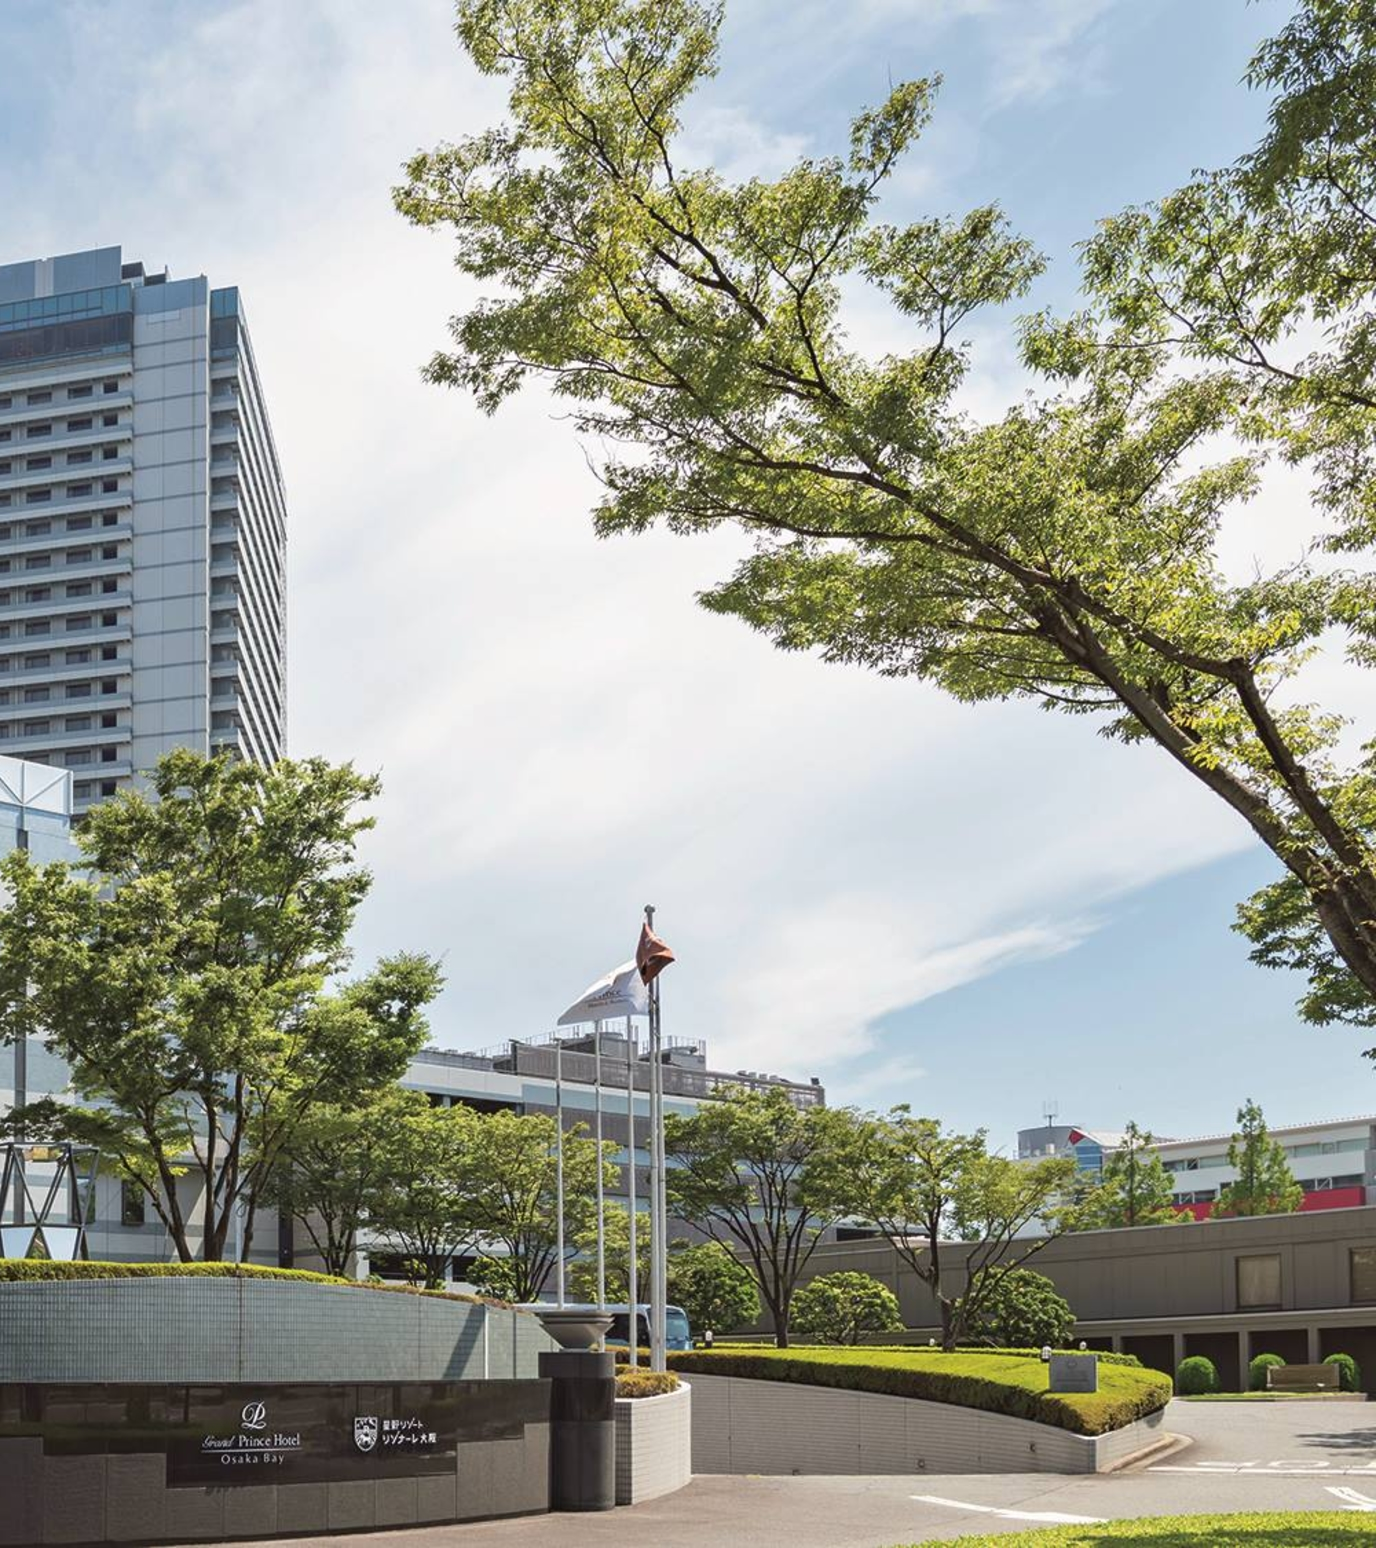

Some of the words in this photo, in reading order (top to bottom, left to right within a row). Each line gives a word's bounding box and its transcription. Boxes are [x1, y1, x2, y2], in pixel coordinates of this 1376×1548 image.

[202, 1435, 236, 1448] Grand
[238, 1434, 272, 1448] Prince
[274, 1432, 301, 1447] Hotel
[220, 1453, 259, 1465] Osaka
[263, 1452, 285, 1465] Bay
